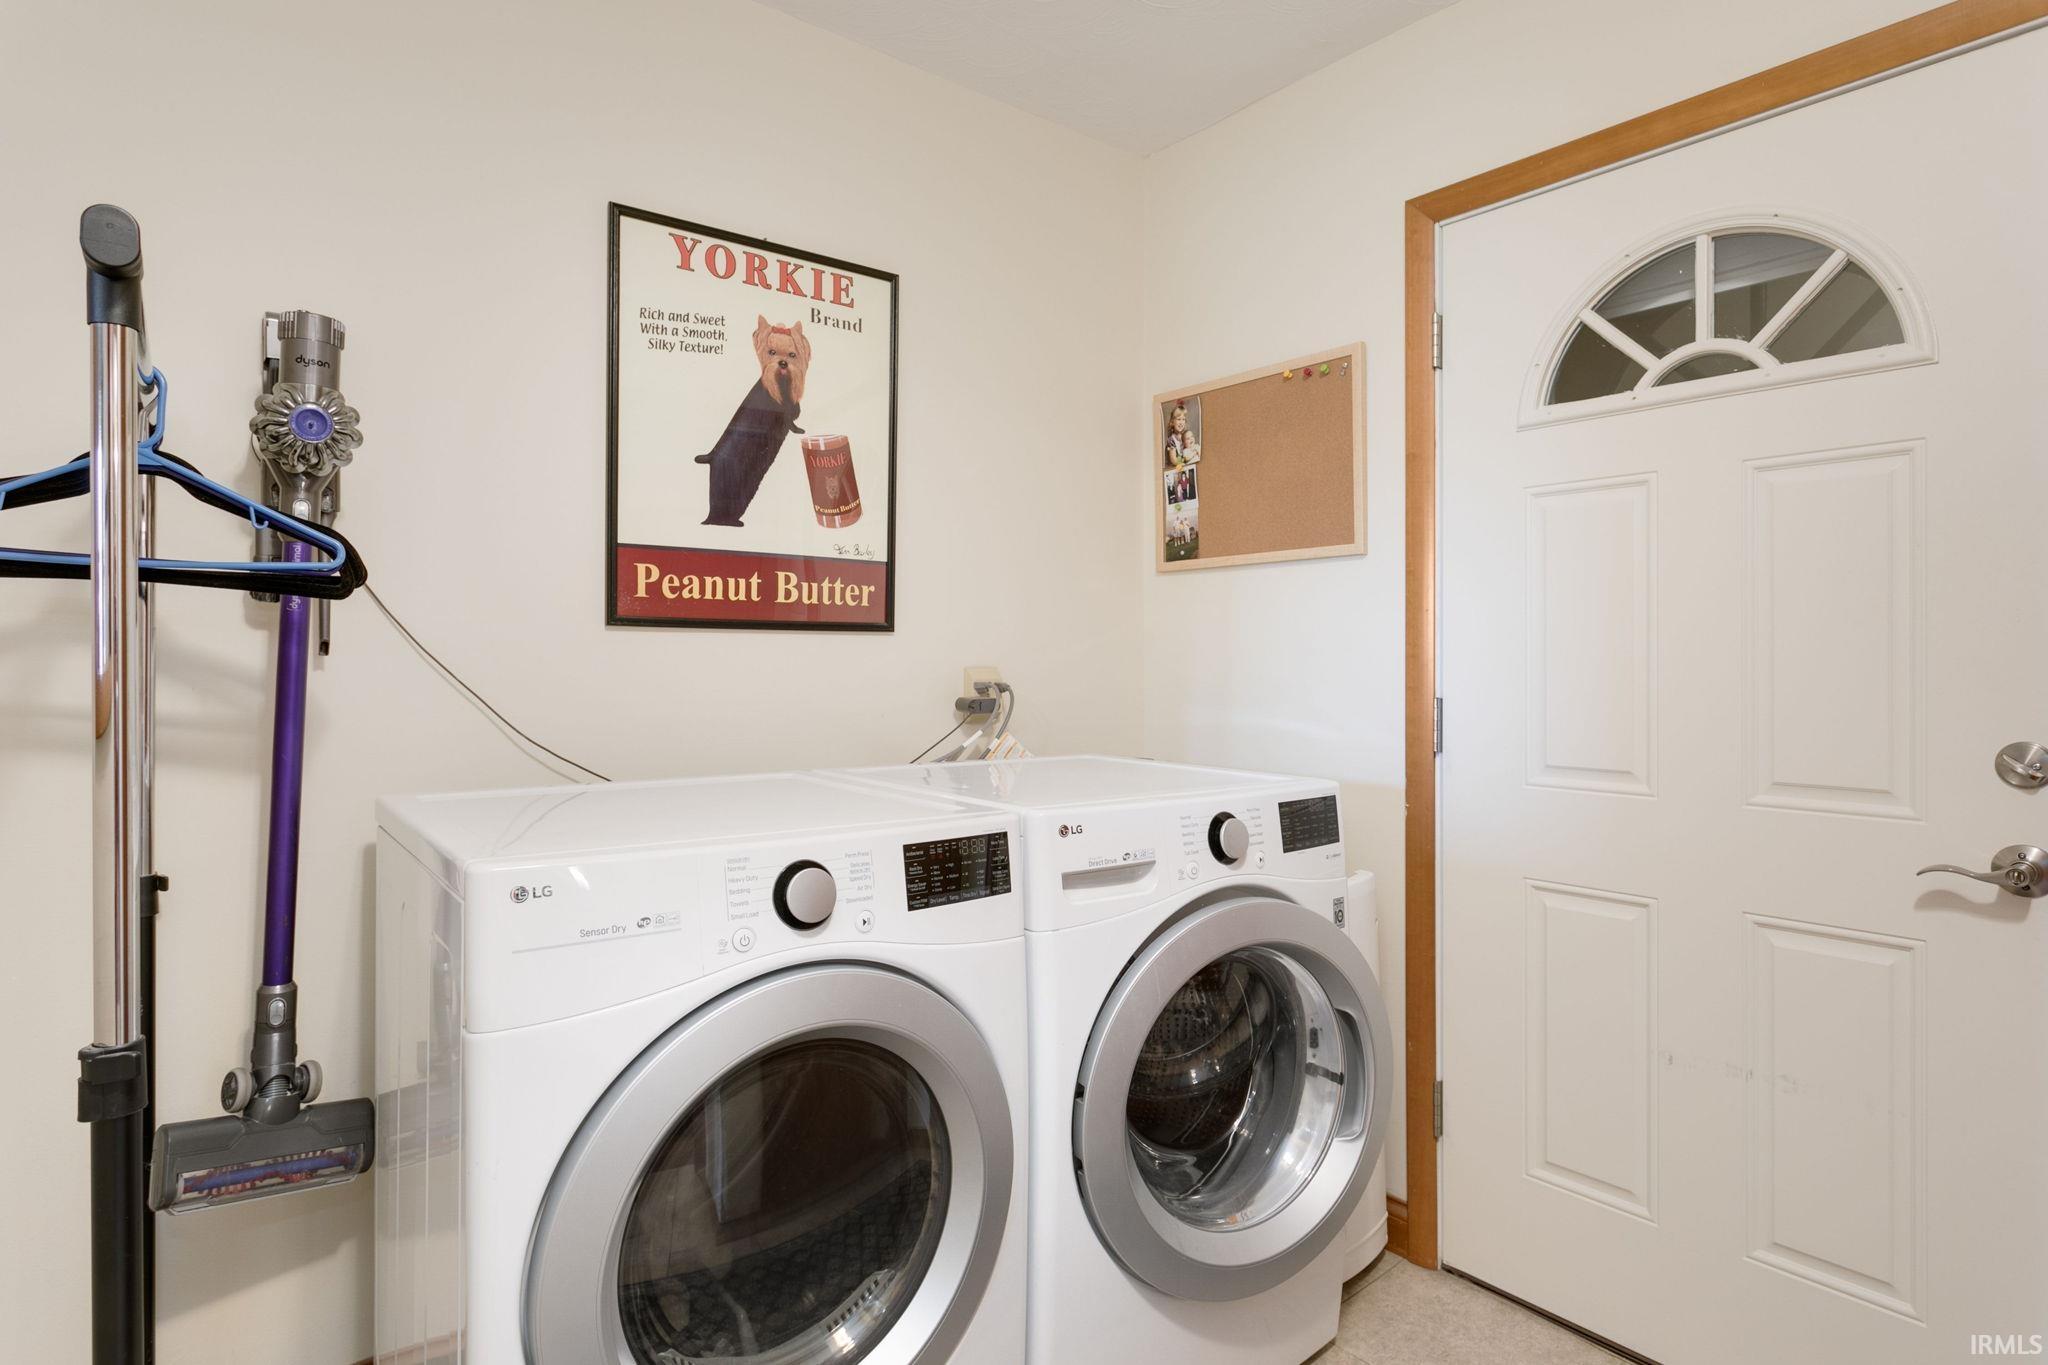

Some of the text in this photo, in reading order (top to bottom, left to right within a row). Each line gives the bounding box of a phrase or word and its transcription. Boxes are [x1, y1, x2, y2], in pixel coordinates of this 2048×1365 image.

[668, 232, 855, 308] YORKIE
[639, 307, 726, 327] Rich and Sweet
[810, 307, 863, 333] Brand
[640, 322, 668, 336] With
[671, 327, 679, 337] a
[648, 337, 724, 355] Silky Texture!
[295, 354, 331, 369] dyson
[809, 451, 848, 469] YORKIE
[814, 498, 861, 514] Peanut Butter
[633, 562, 876, 608] Peanut Butter
[1070, 825, 1083, 835] LG
[532, 886, 553, 899] LG
[579, 924, 627, 938] Sensor Dry
